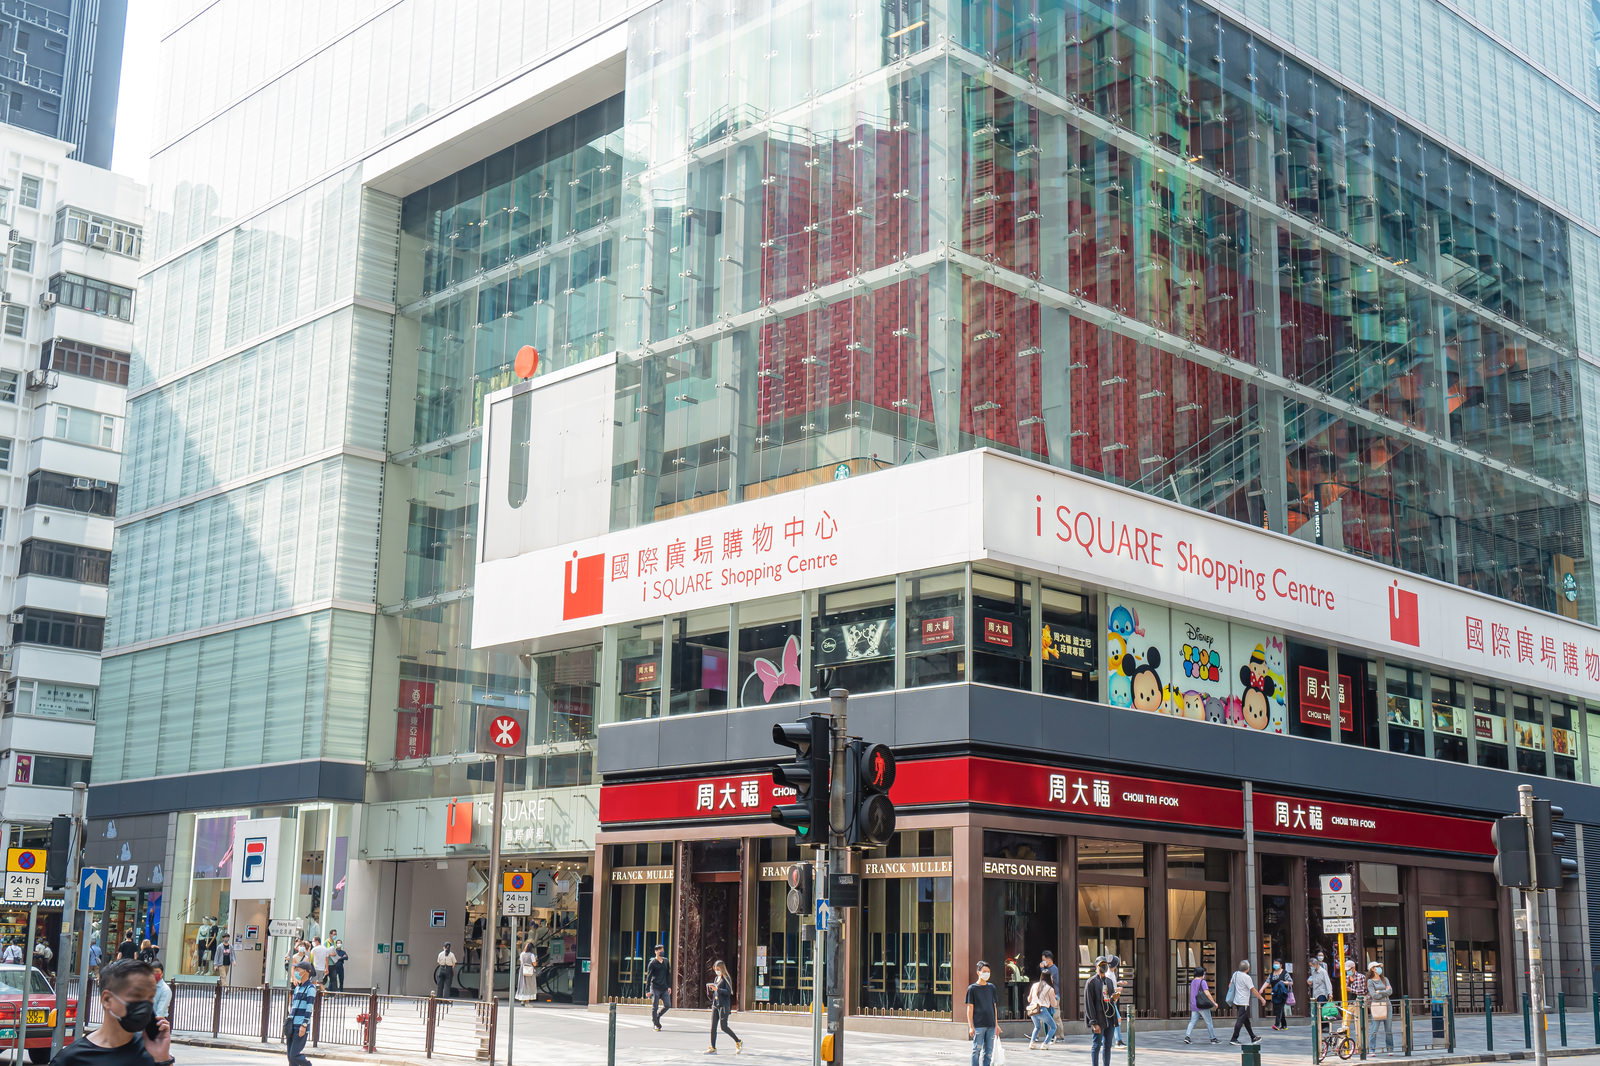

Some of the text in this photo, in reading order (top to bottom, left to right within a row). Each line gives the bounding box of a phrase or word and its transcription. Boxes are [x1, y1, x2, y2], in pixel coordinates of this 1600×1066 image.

[611, 510, 838, 582] 國際廣場購物中心
[1036, 494, 1336, 611] i SQUARE Shopping Centre
[653, 571, 713, 601] SQUARE
[721, 561, 783, 588] Shopping
[787, 553, 838, 574] Centre
[926, 620, 949, 633] 周大福
[988, 621, 1009, 635] 周大福
[1053, 631, 1072, 644] 周大福
[1184, 622, 1214, 648] Disney
[1466, 615, 1600, 682] 國際廣場購物
[1476, 718, 1491, 730] 周大福
[696, 780, 759, 811] 周大福
[772, 787, 797, 797] CHOW
[1049, 774, 1111, 808] 周大福
[1122, 791, 1179, 807] CHOW TAI FOOK
[1275, 801, 1323, 831] 周大福
[1331, 816, 1376, 829] CHOW TAI FOOK
[612, 869, 644, 881] FRANCK
[762, 866, 790, 877] FRAN
[865, 863, 907, 875] FRANCK
[1019, 865, 1033, 876] ON
[1035, 866, 1057, 877] FIRE
[10, 875, 40, 885] 24 hrs
[108, 865, 139, 888] MLB
[12, 887, 36, 898] 全日
[517, 894, 529, 902] hrs
[1341, 895, 1346, 903] 7
[508, 903, 525, 913] 全日
[1342, 907, 1347, 915] 7
